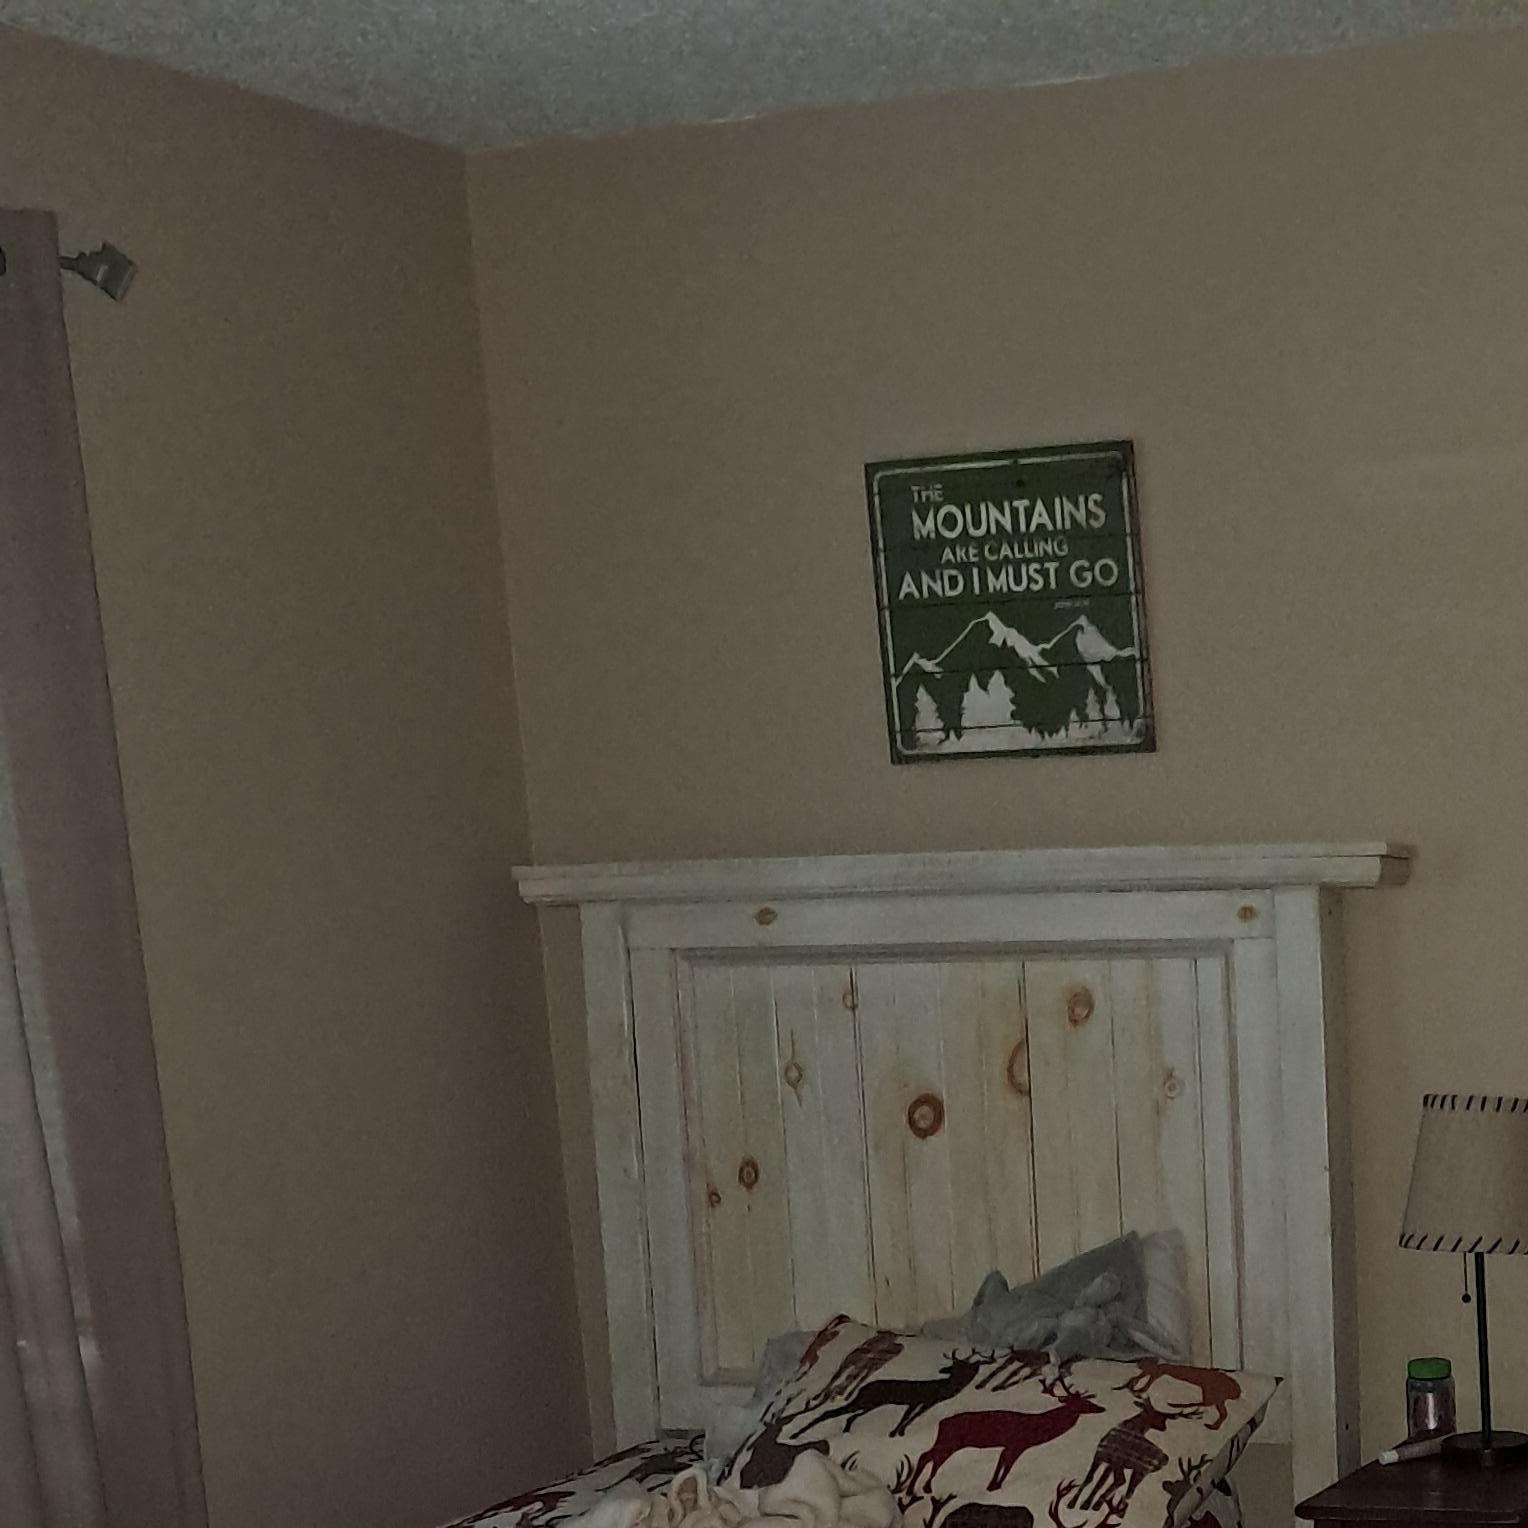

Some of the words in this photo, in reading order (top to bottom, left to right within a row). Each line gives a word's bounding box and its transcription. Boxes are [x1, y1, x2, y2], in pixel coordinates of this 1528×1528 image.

[911, 483, 944, 503] THE
[911, 493, 1106, 540] MOUNTAINS
[941, 544, 979, 564] ARE
[984, 536, 1069, 561] CALLING
[899, 568, 964, 600] AND
[972, 566, 981, 595] I
[986, 562, 1060, 593] MUST
[1069, 558, 1119, 588] GO
